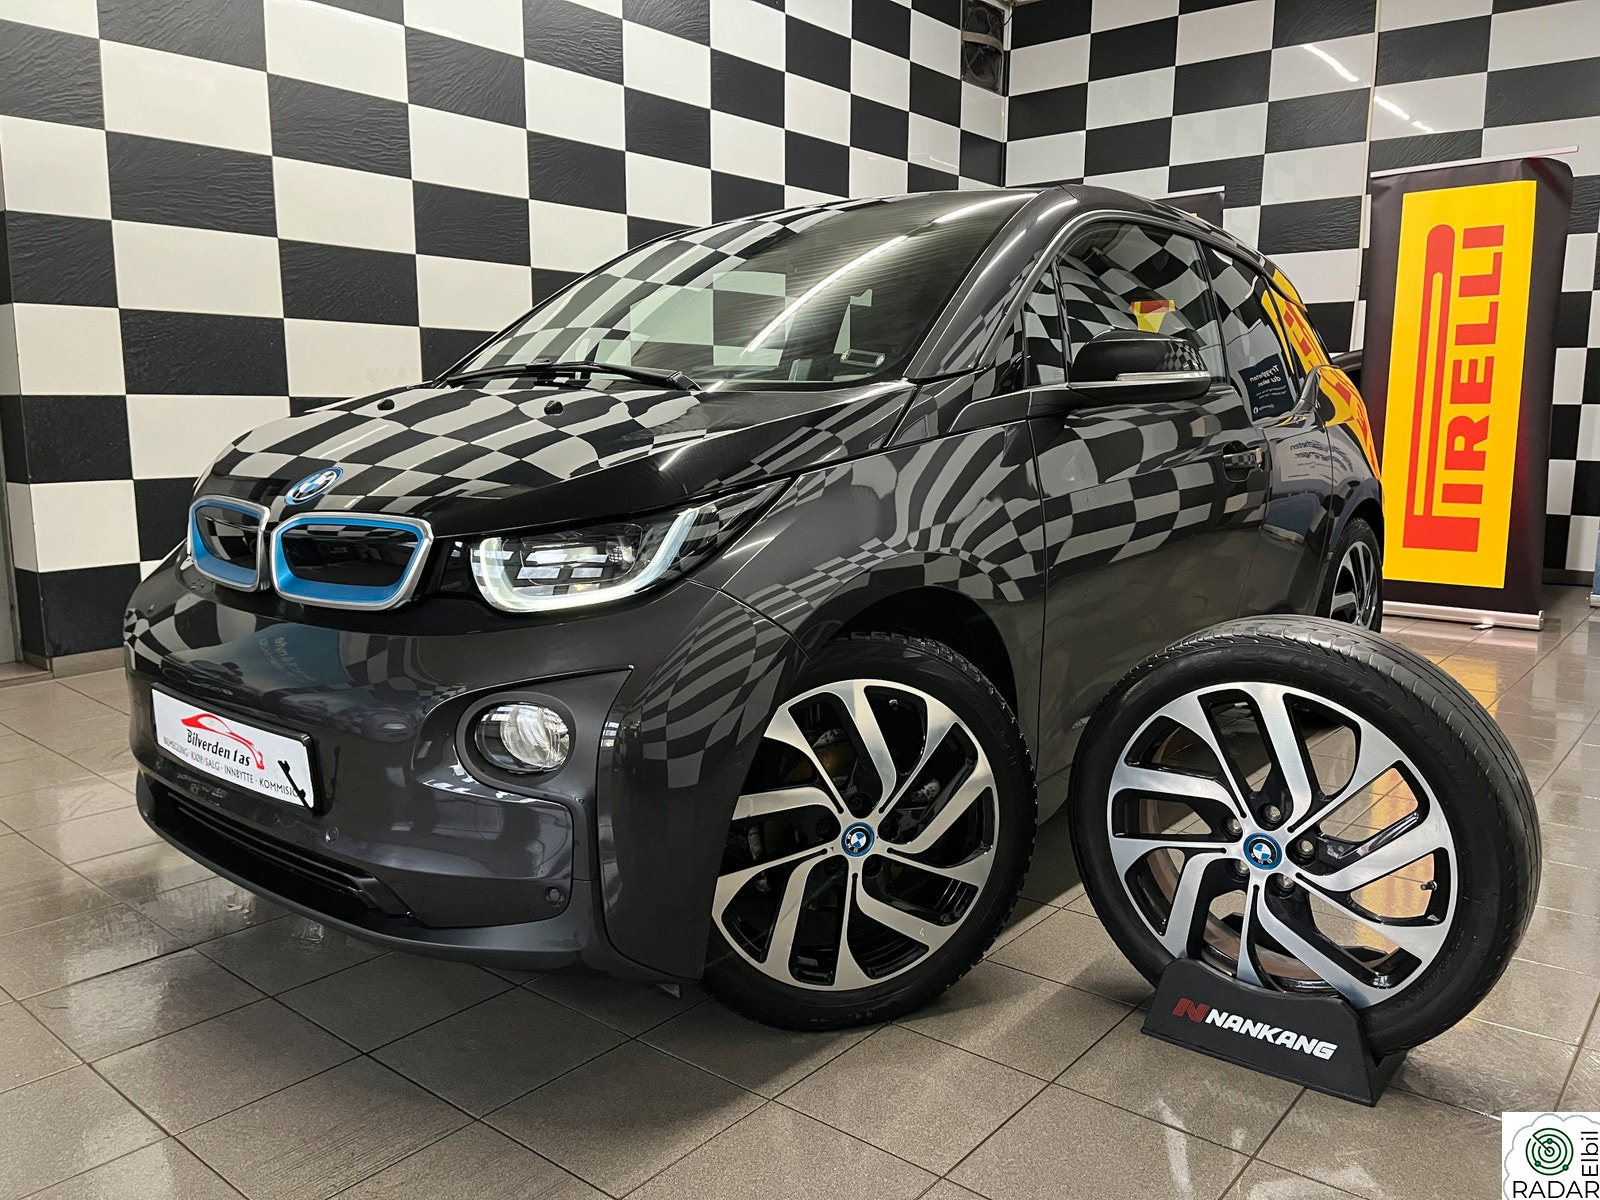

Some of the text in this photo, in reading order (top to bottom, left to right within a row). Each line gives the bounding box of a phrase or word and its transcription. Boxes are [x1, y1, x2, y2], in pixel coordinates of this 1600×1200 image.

[1402, 223, 1505, 553] PIRELLI
[186, 728, 230, 760] Bilverden
[239, 754, 251, 767] as
[1205, 1008, 1338, 1061] NANKANG
